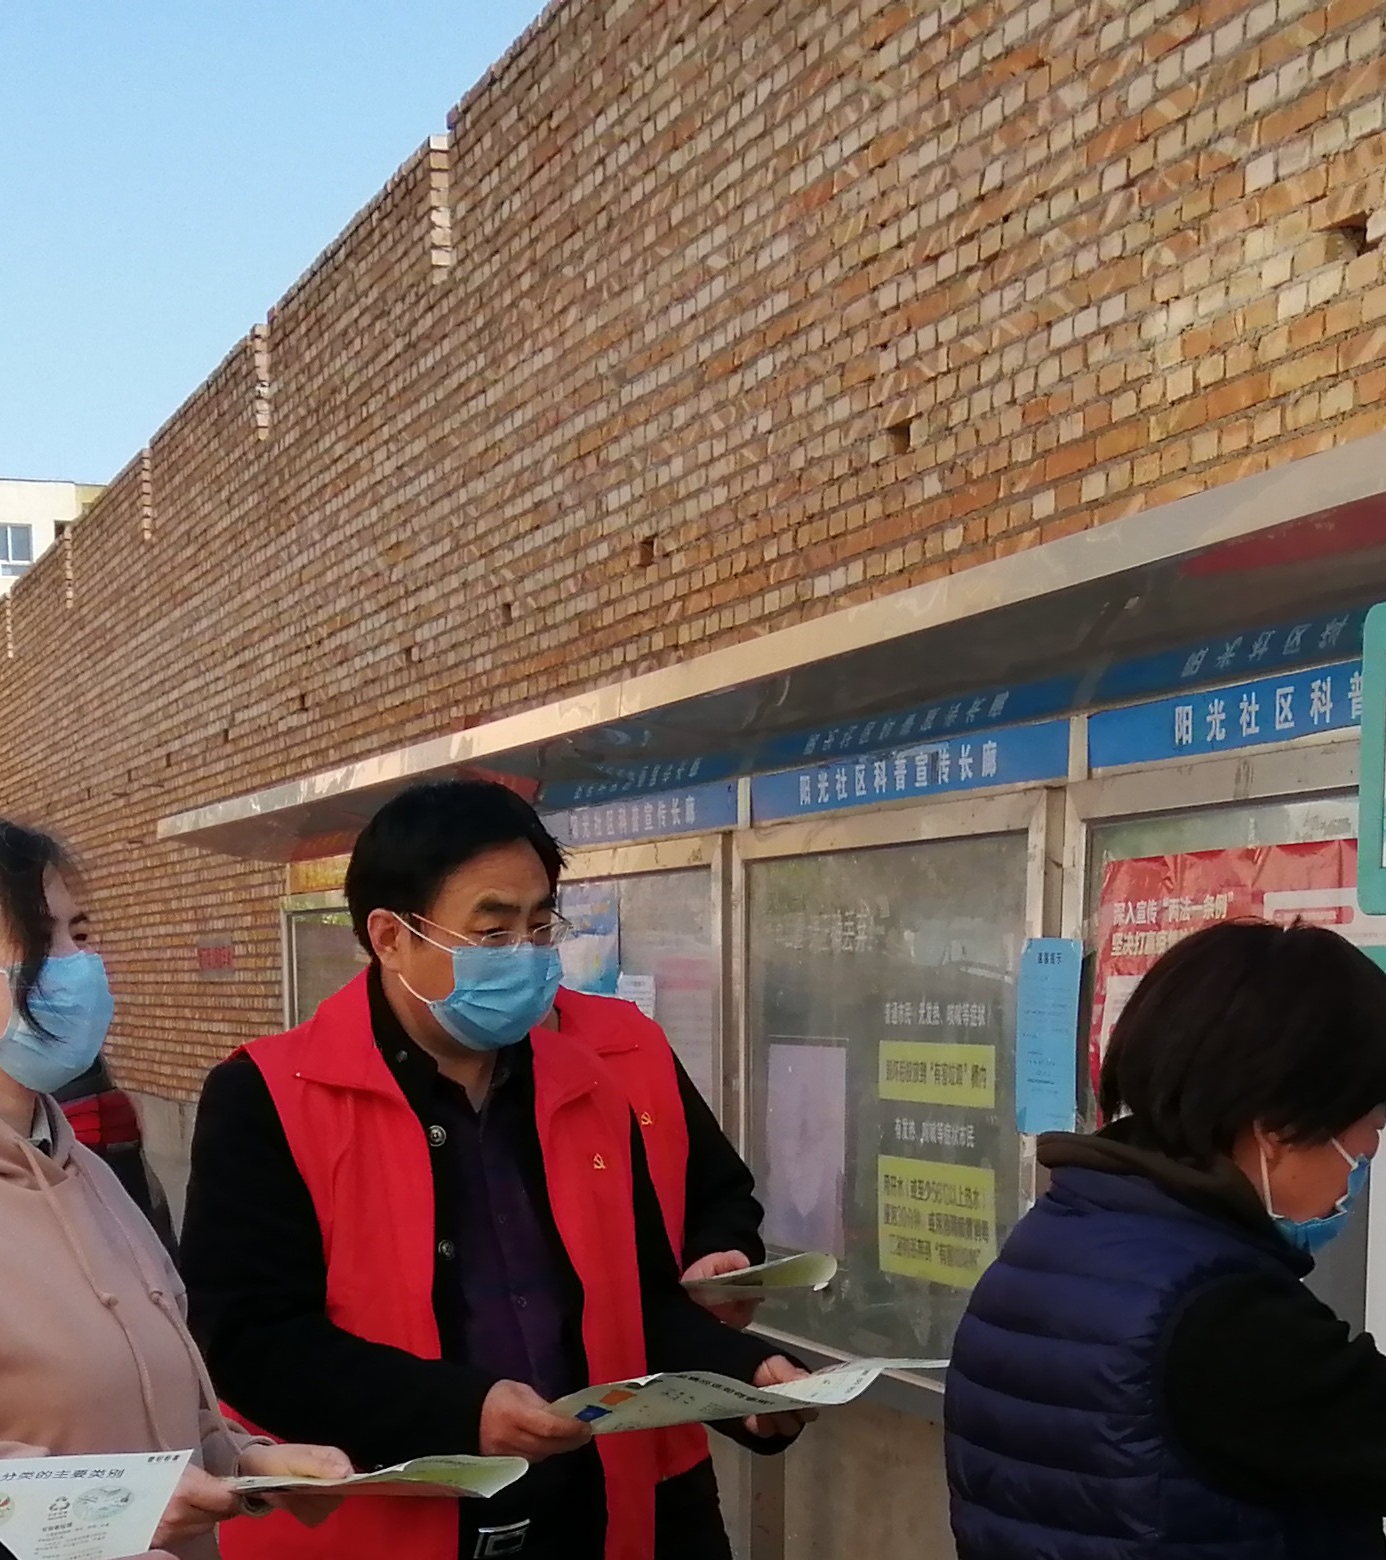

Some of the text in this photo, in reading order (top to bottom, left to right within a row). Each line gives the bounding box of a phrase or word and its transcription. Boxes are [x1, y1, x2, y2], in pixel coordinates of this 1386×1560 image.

[799, 741, 999, 807] 阳光社区科普宣传长廊
